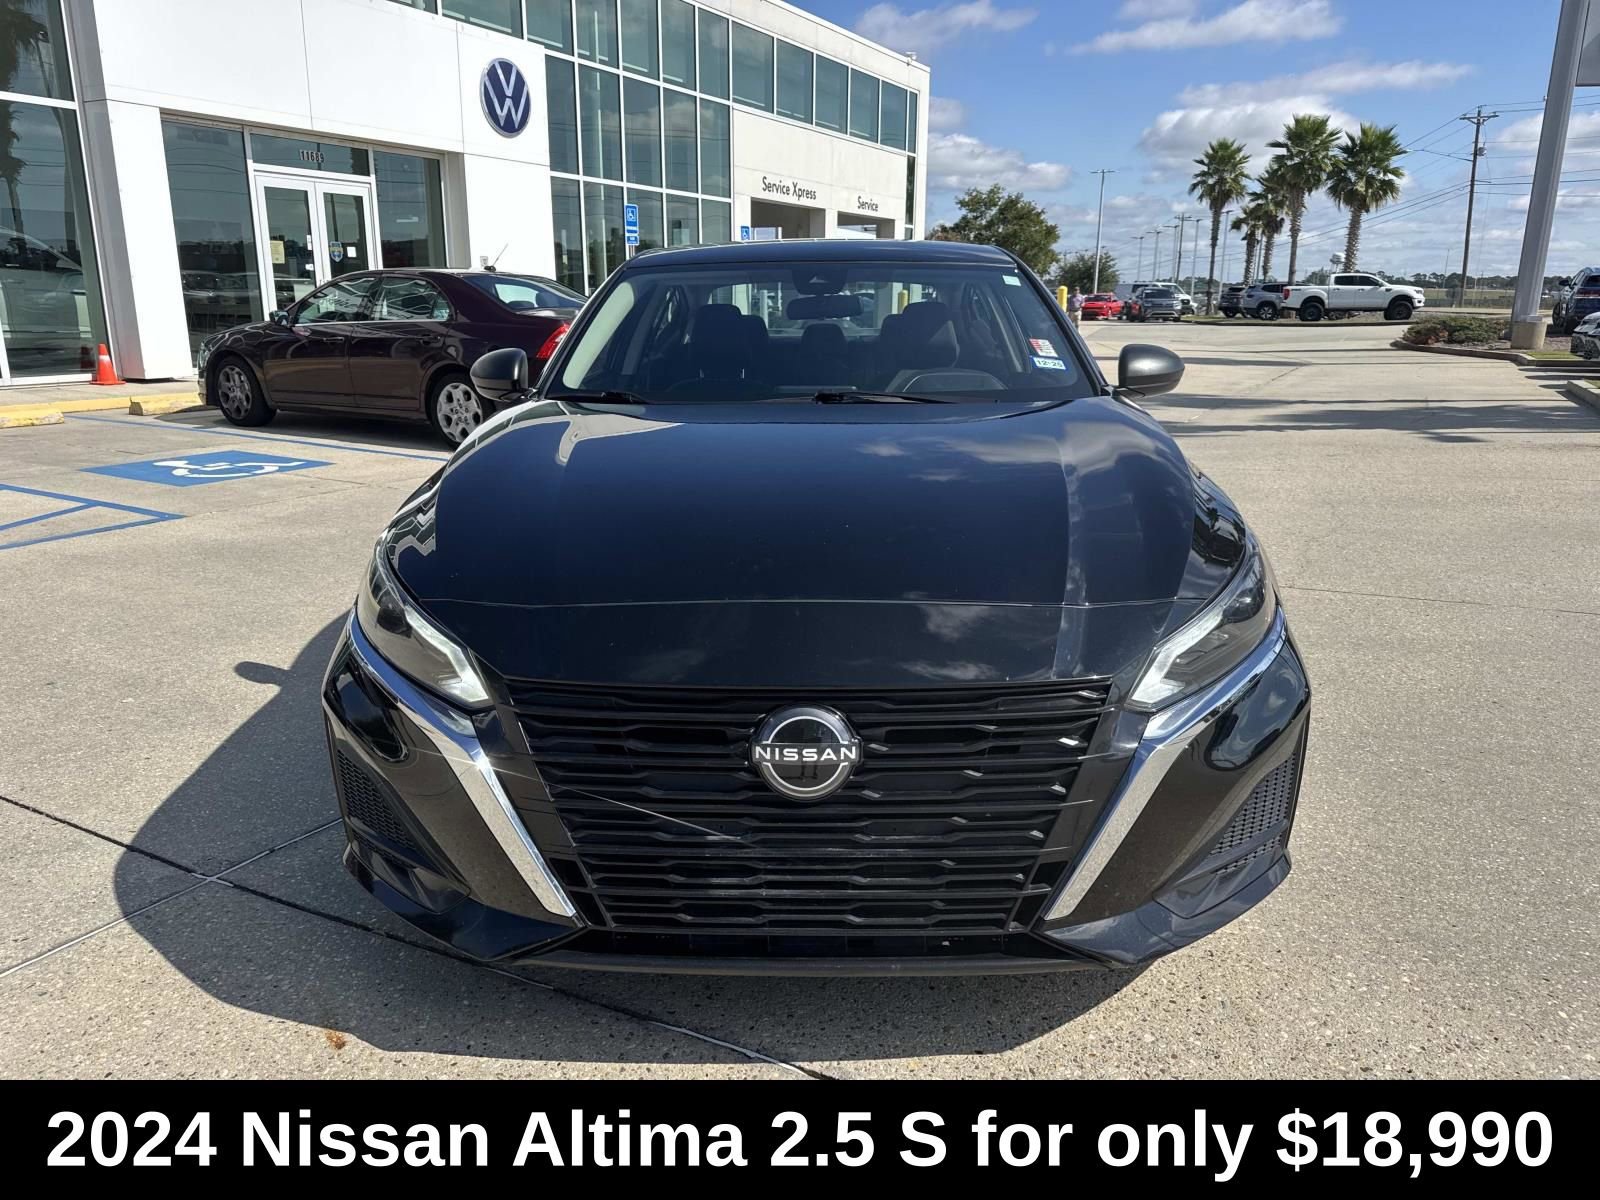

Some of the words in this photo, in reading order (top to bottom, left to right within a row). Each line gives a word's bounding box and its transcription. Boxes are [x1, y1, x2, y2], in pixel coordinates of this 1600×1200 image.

[482, 59, 529, 131] VW
[762, 176, 790, 196] Service
[792, 181, 817, 201] Xpress
[857, 195, 879, 212] Service
[755, 746, 856, 761] NISSAN
